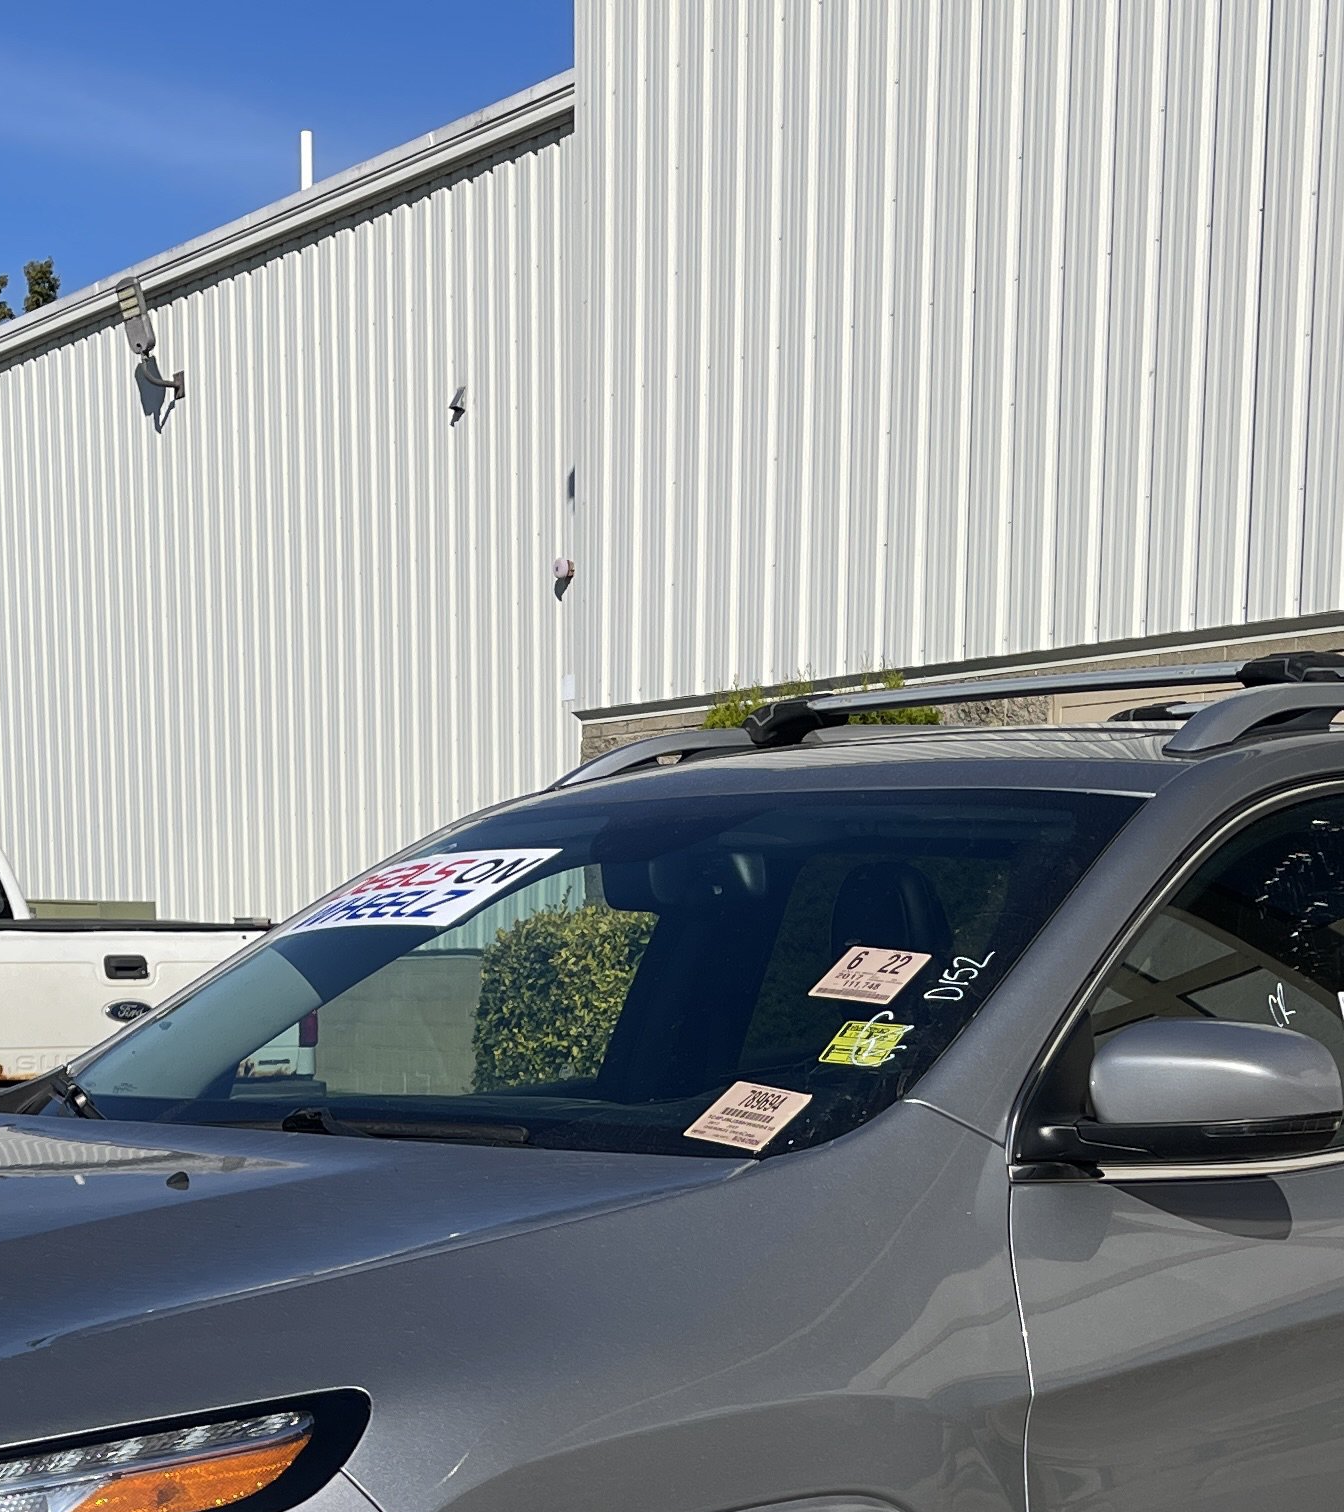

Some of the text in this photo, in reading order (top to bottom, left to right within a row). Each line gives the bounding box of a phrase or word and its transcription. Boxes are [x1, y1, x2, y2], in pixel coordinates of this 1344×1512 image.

[452, 858, 545, 885] ON
[291, 888, 477, 931] WHEELZ
[846, 951, 913, 975] 6 22
[923, 950, 996, 1001] D152
[835, 971, 864, 981] 2017
[737, 1089, 788, 1113] 789694
